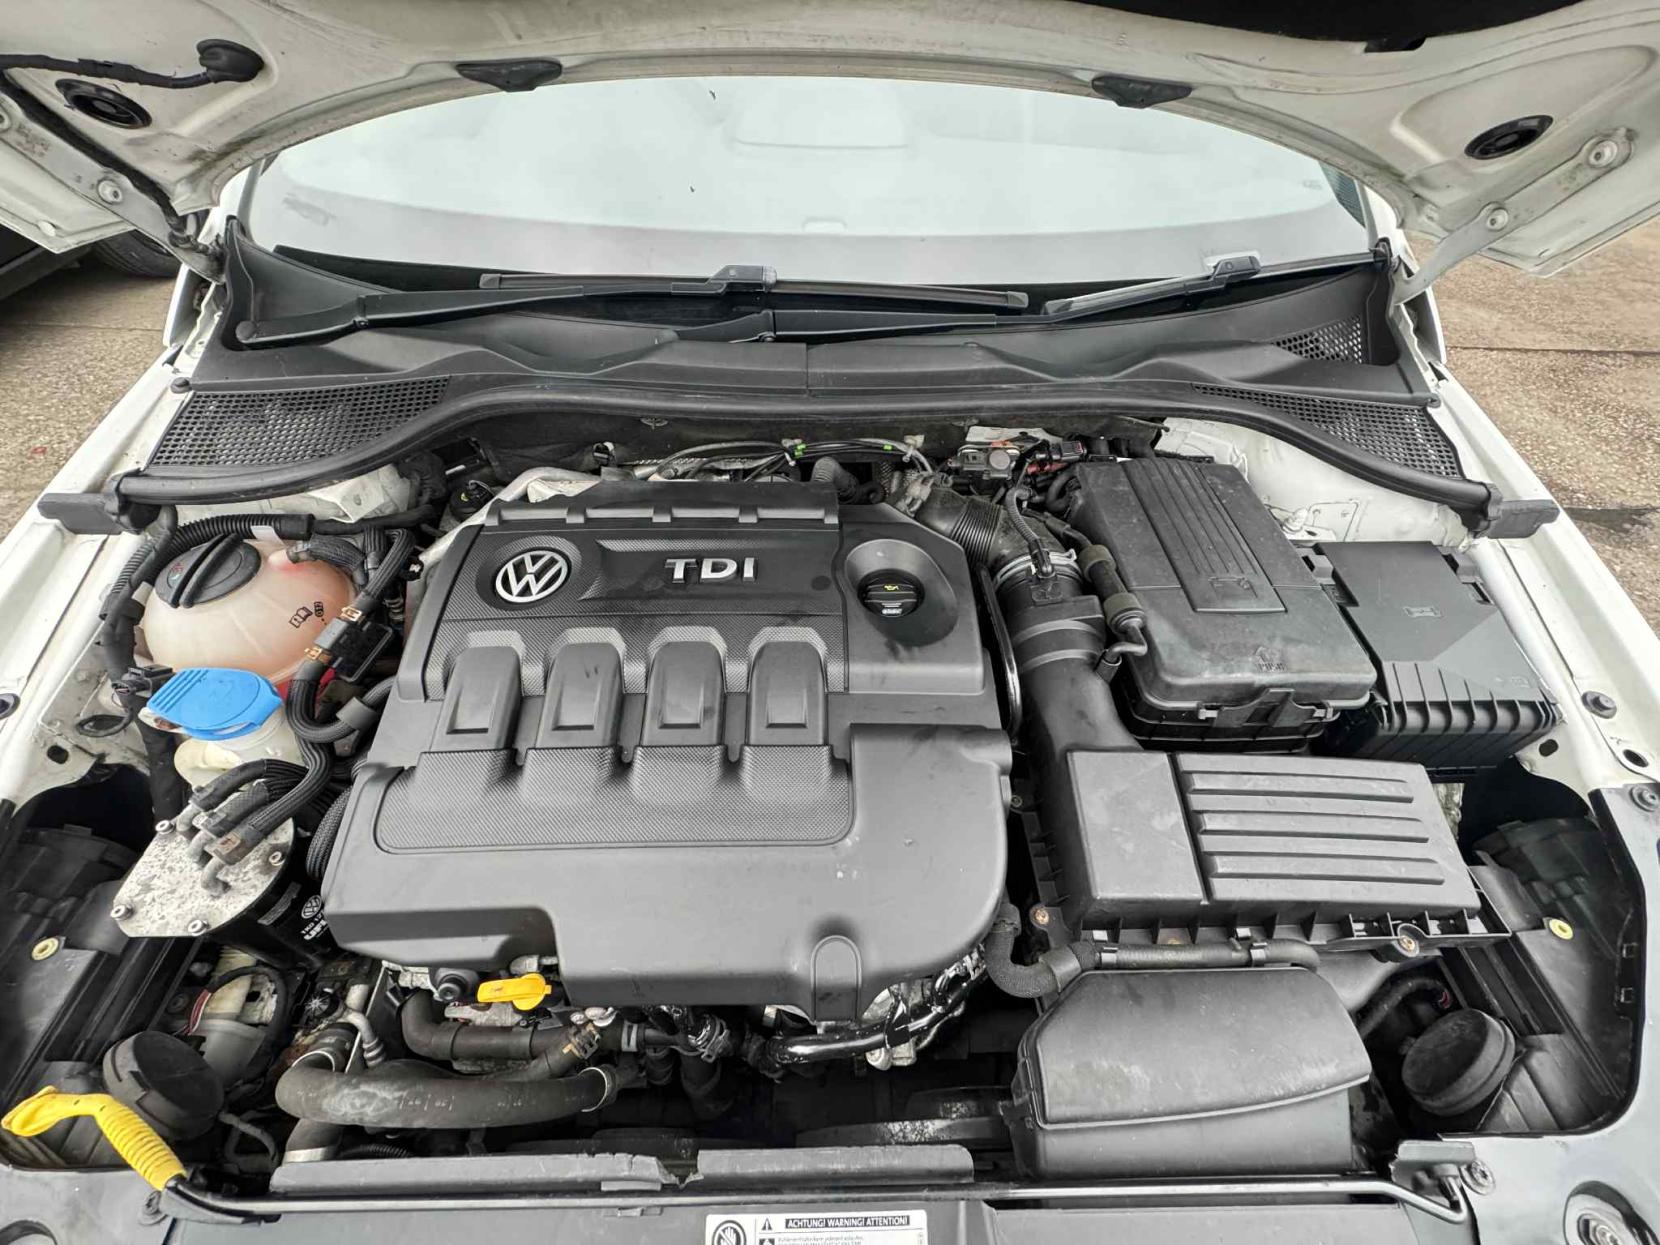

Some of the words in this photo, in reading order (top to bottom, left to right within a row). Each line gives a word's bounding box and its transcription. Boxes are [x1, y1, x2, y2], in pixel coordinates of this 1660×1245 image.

[495, 550, 568, 603] VW
[664, 557, 755, 584] TDI
[788, 1218, 825, 1228] ACHTUNG!
[827, 1217, 865, 1227] WARNING!
[866, 1216, 908, 1226] ATTENTION!
